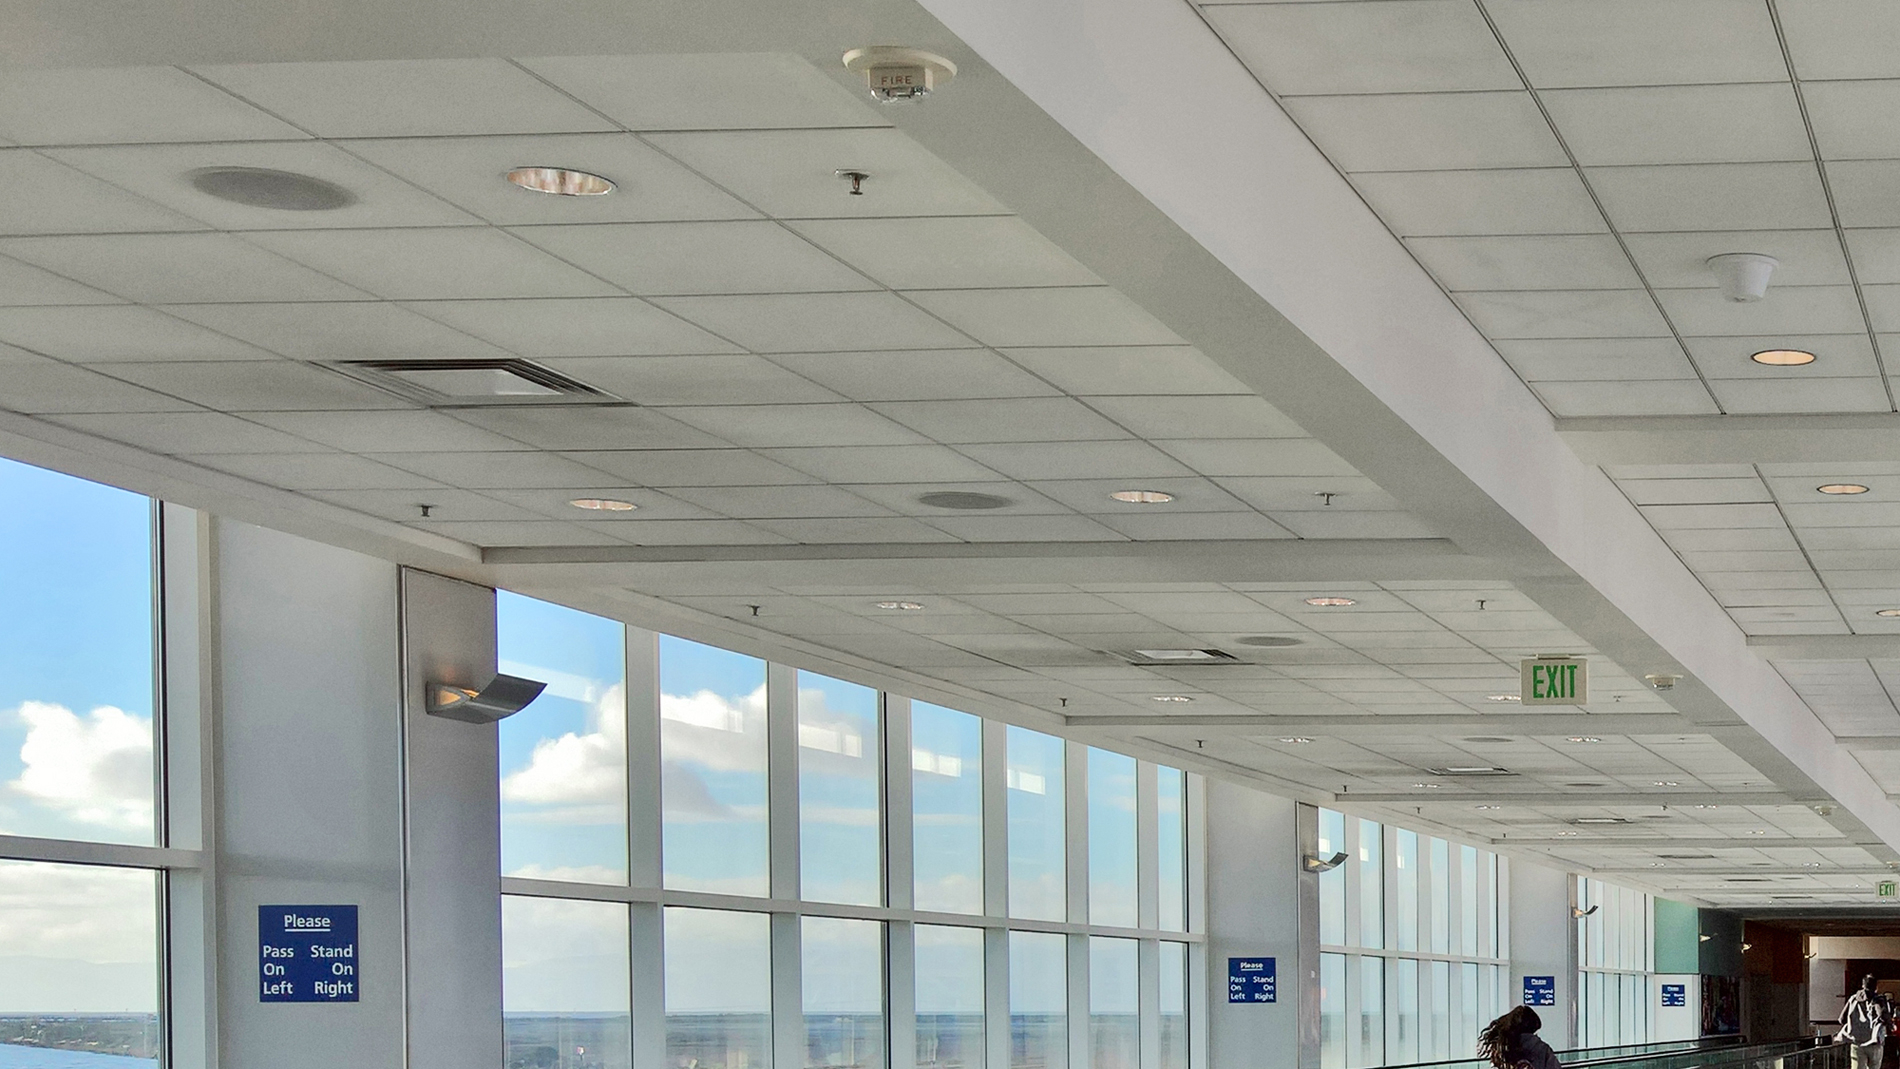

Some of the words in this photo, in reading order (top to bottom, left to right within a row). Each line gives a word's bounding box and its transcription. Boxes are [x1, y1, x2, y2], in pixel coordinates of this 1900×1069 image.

[881, 76, 913, 85] FIRE
[1533, 665, 1577, 698] EXIT
[1879, 884, 1896, 896] EXIT
[284, 914, 331, 928] Please
[263, 945, 294, 958] Pass
[311, 945, 353, 958] Stand
[263, 963, 285, 976] On
[332, 963, 353, 976] On
[263, 981, 294, 995] Left
[314, 981, 353, 997] Right
[1255, 993, 1274, 1001] Right
